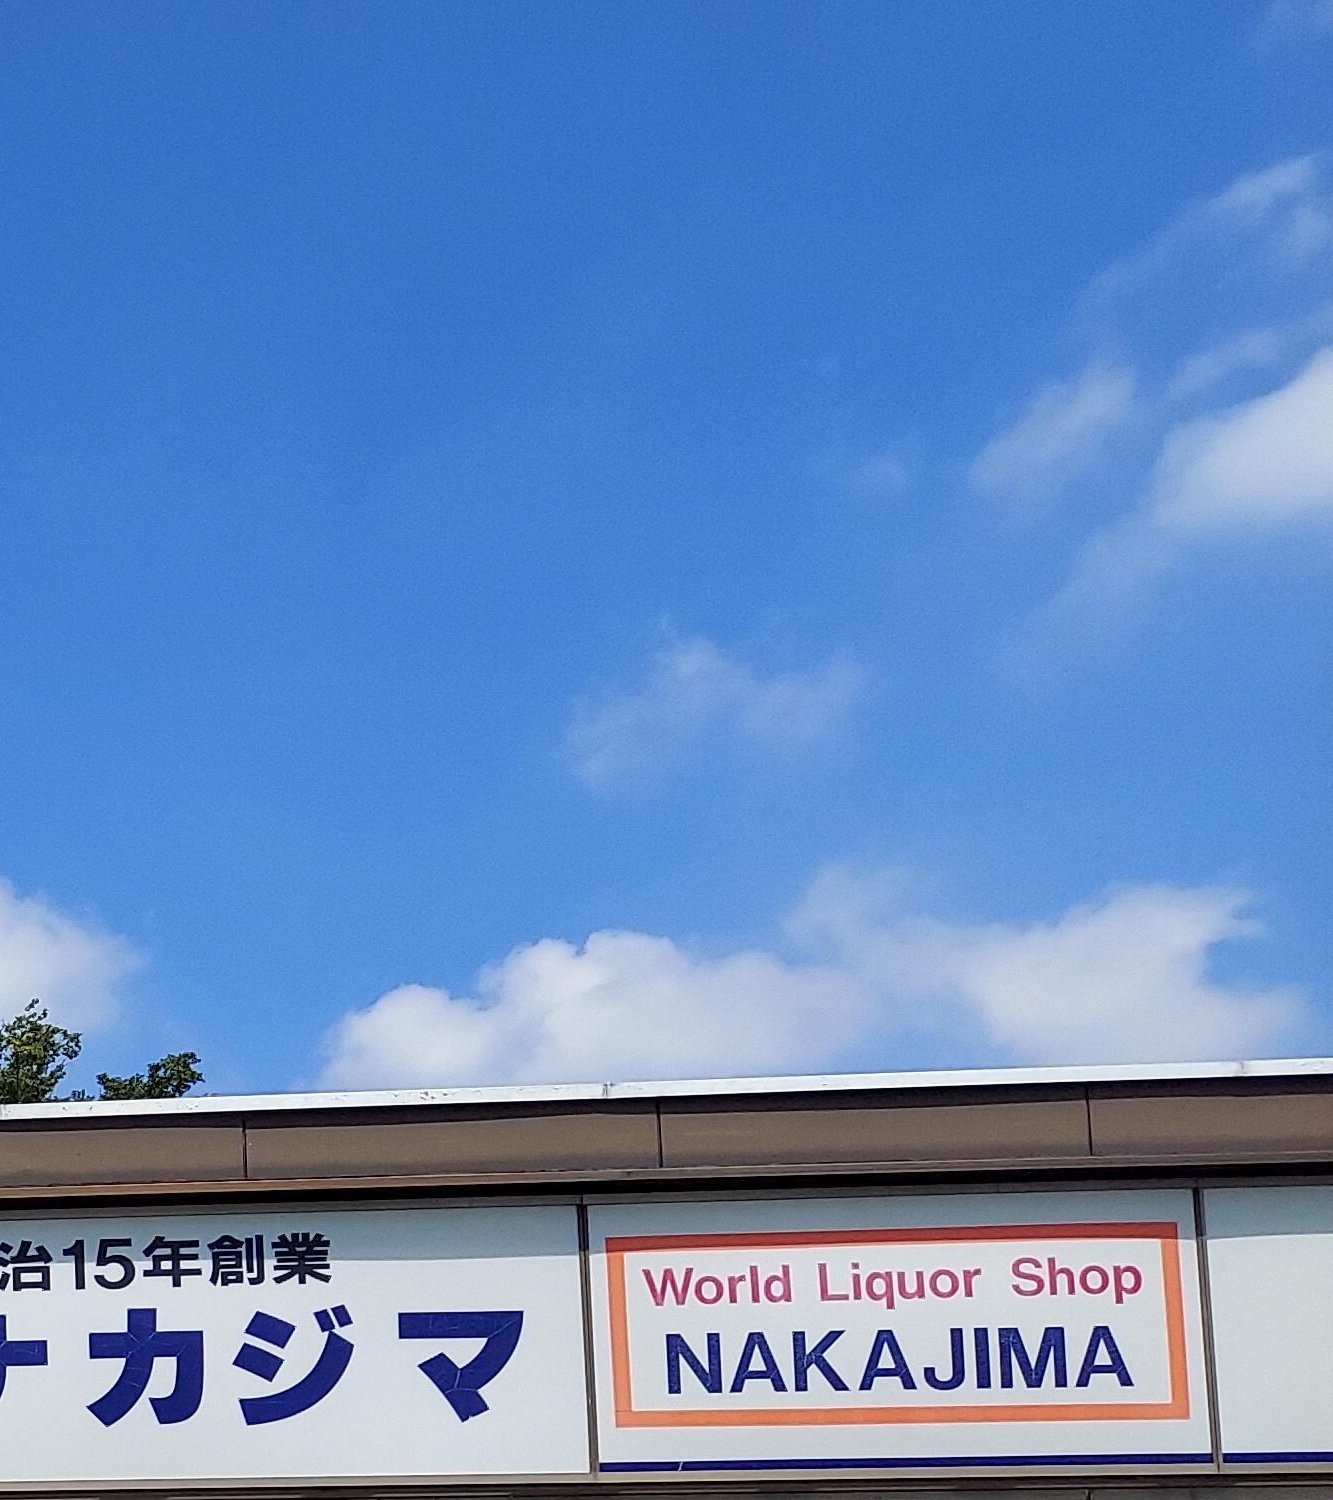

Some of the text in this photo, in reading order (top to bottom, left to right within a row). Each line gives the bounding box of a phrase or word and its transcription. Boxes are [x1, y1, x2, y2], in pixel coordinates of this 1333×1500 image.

[642, 1256, 1143, 1310] World Liquor Shop
[665, 1325, 1135, 1395] NAKAJIMA
